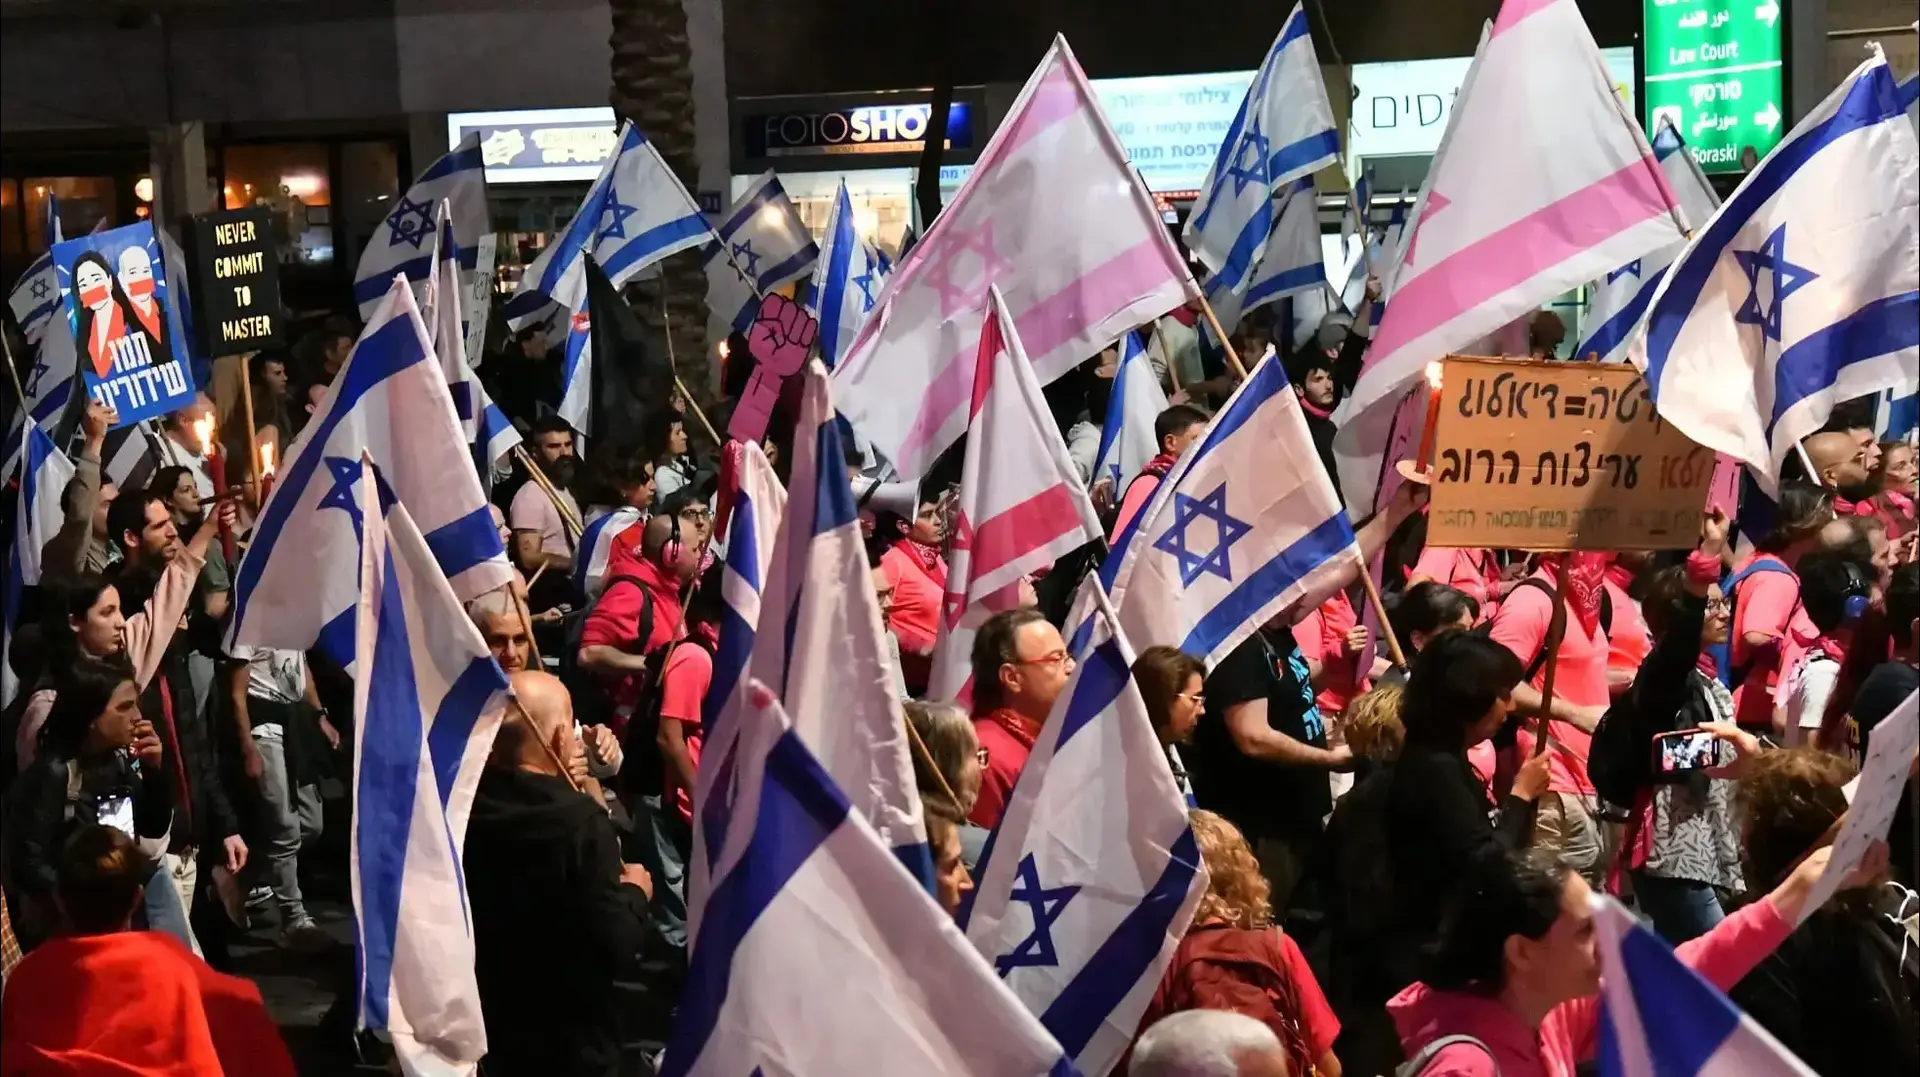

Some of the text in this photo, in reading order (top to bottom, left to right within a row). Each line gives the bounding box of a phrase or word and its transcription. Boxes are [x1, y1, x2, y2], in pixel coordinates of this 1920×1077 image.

[1669, 40, 1739, 66] Law Court
[1373, 87, 1460, 128] סים
[765, 107, 932, 145] FOTOSHO
[1127, 146, 1164, 160] תמונ
[1691, 143, 1738, 163] Soraski
[215, 221, 256, 246] NEVER
[215, 252, 263, 278] COMMIT
[234, 286, 251, 307] TO
[222, 315, 272, 342] MASTER
[1438, 448, 1520, 485] הרוב
[1531, 441, 1642, 490] עריצות
